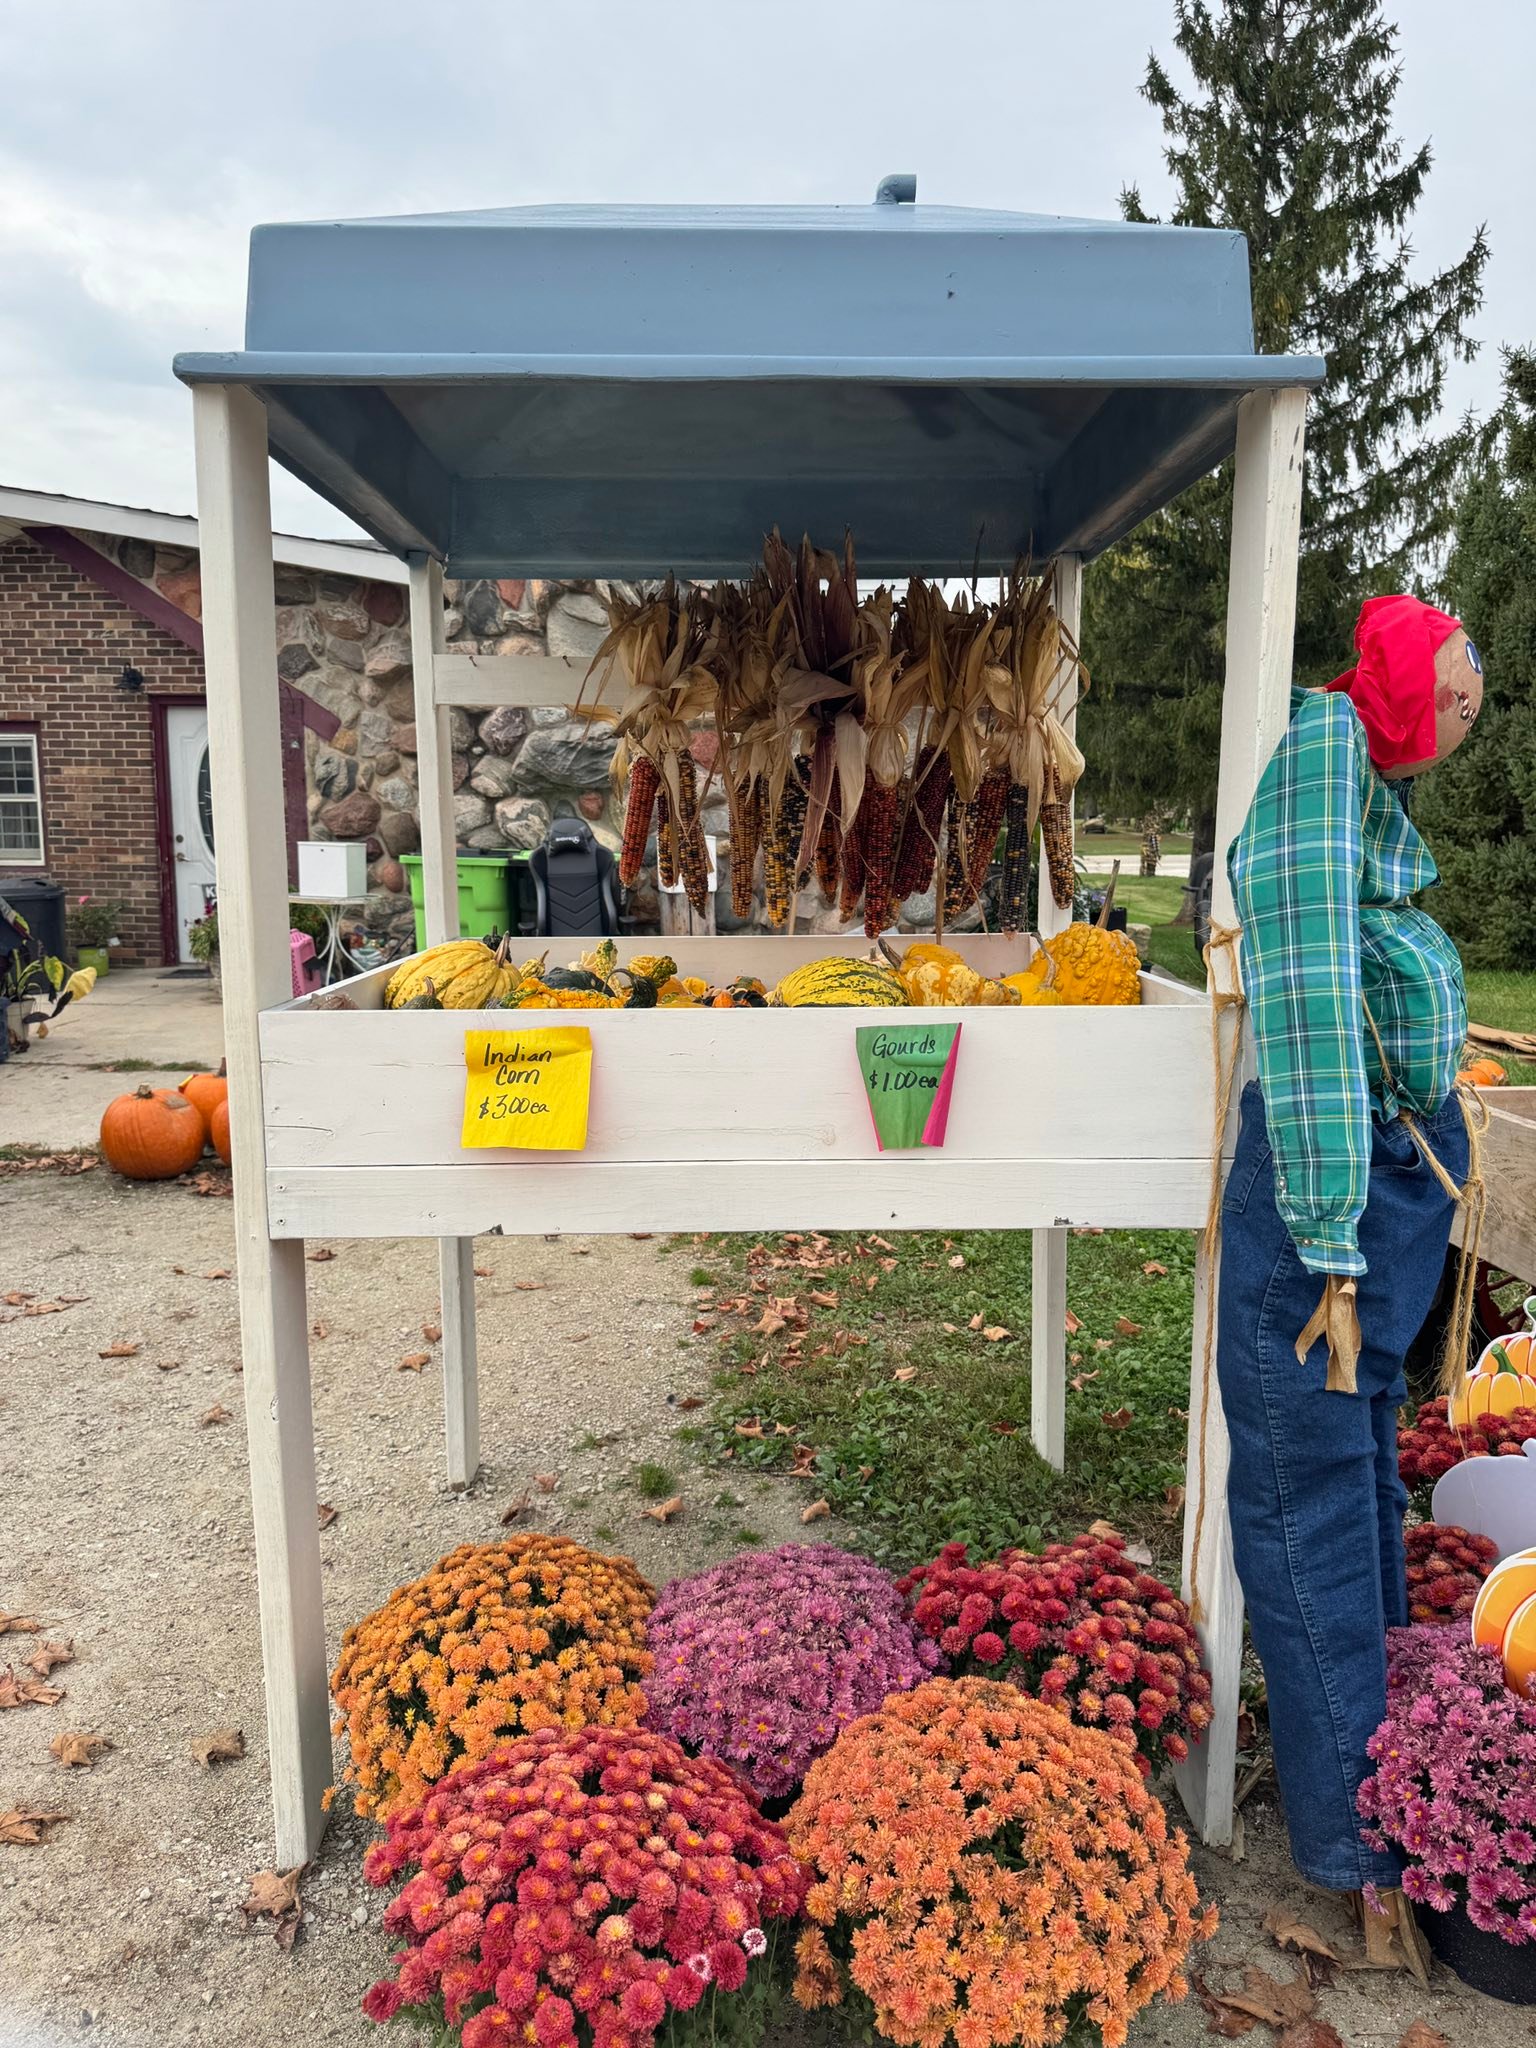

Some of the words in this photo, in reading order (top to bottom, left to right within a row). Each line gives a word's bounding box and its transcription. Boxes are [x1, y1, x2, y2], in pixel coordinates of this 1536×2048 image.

[483, 1043, 552, 1066] Indian
[872, 1033, 936, 1059] Gourds
[495, 1064, 540, 1086] Corn
